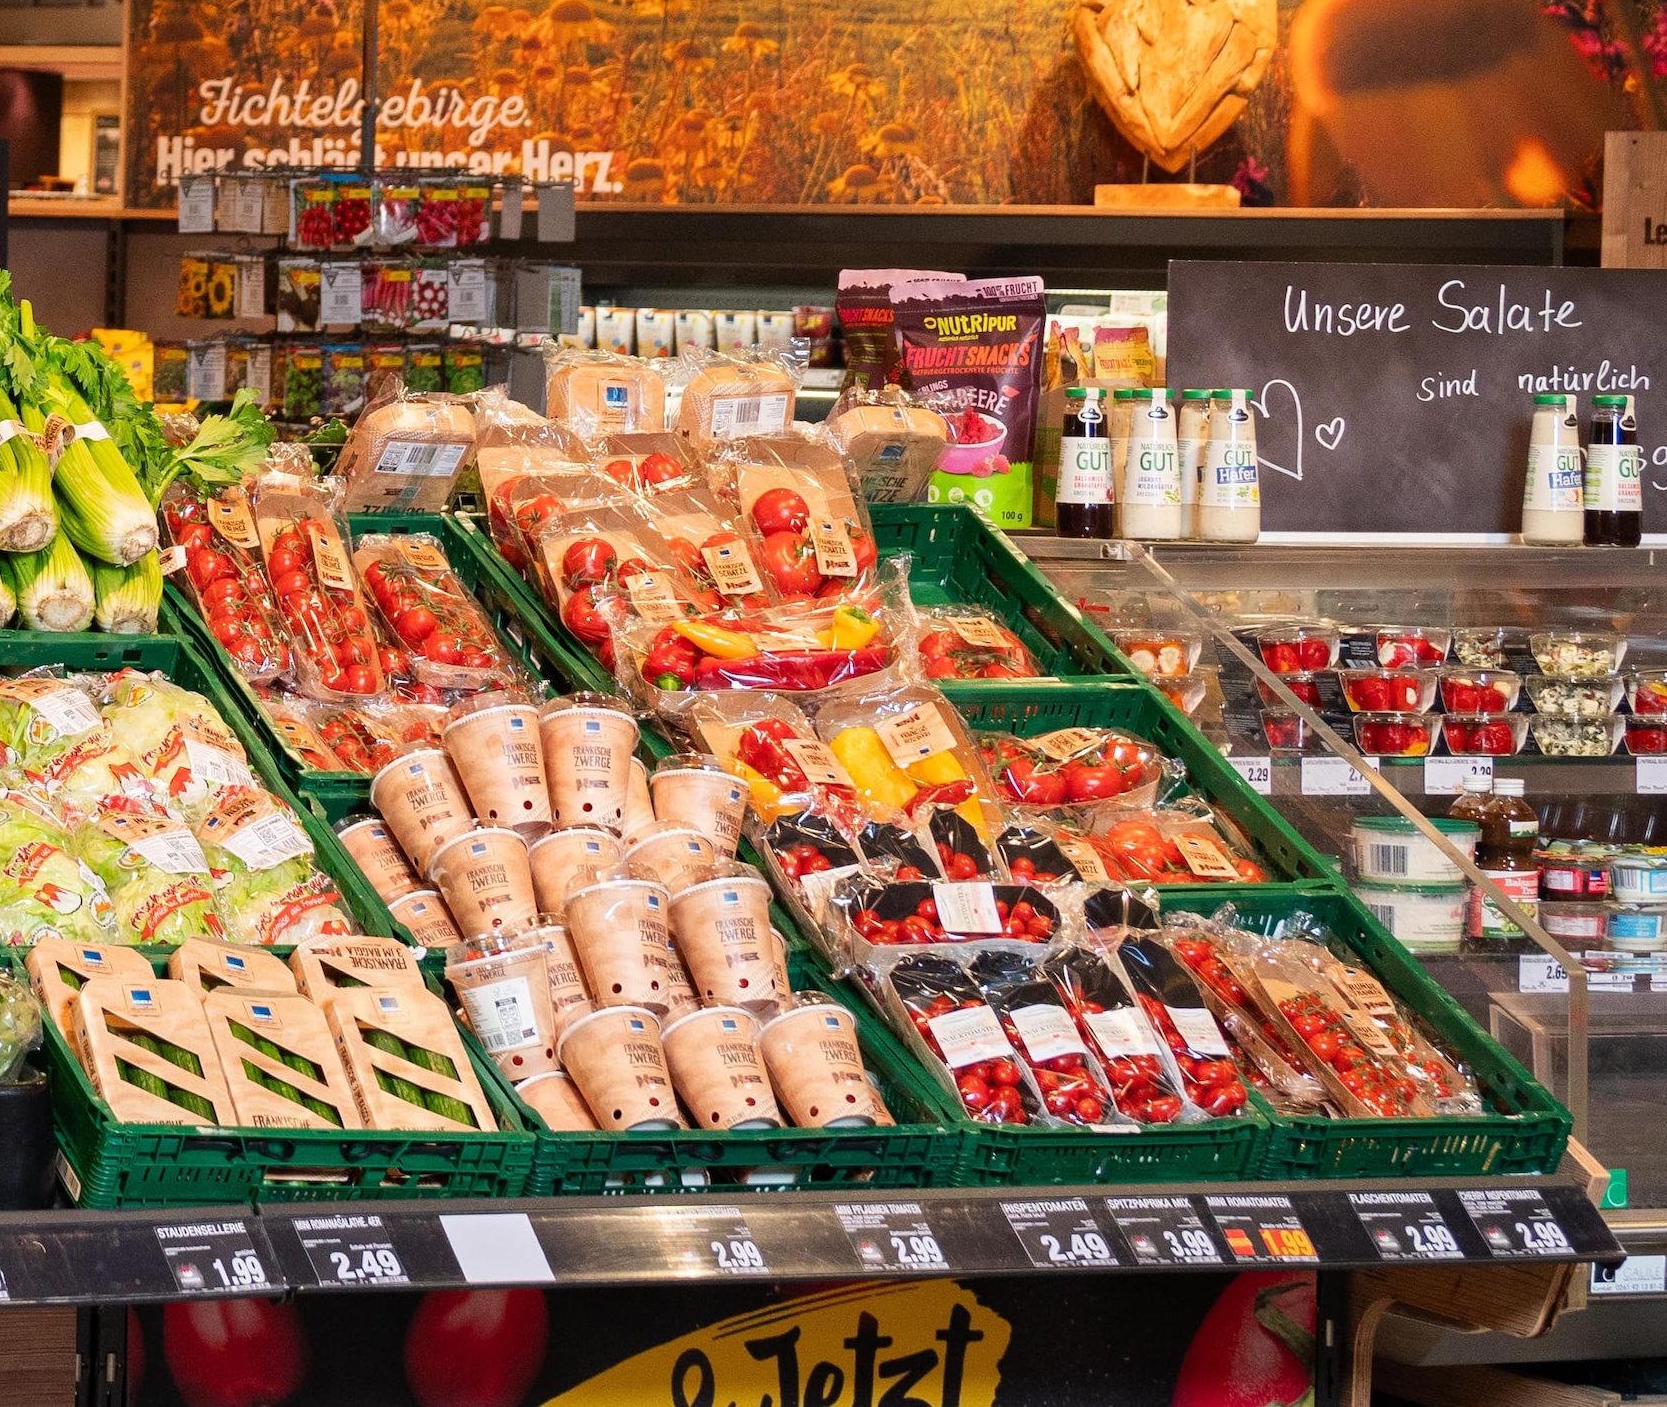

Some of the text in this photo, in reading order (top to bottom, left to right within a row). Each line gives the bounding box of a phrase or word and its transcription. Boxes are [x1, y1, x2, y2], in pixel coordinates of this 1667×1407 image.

[156, 136, 235, 187] Hier
[521, 139, 624, 194] Herz.
[1005, 281, 1038, 295] FRUCHT
[1284, 279, 1584, 337] Unsere Salate
[904, 342, 1030, 370] FRUCHTSNACKS
[1416, 360, 1650, 402] sind natürlich
[1076, 451, 1108, 471] GUT
[1139, 451, 1174, 471] GUT
[1223, 451, 1252, 466] GUT
[1218, 467, 1255, 482] Hafer
[1619, 459, 1639, 478] GU
[1001, 511, 1023, 522] 100 g
[574, 757, 611, 769] ZWERGE
[1248, 768, 1268, 782] 2.29
[470, 875, 509, 891] ZWERGE
[718, 929, 756, 944] ZWERGE
[629, 1054, 661, 1068] ZWERGE
[723, 1053, 757, 1068] ZWERGE
[825, 1050, 860, 1066] ZWERGE
[1004, 1201, 1088, 1214] RISPENTOMATEN
[1107, 1198, 1193, 1210] SPITZPAPRIKA MIX
[1349, 1192, 1433, 1204] FLASCHENTOMATEN
[157, 1223, 246, 1239] STAUDENSELLERIE
[1405, 1225, 1458, 1252] 2.99
[1515, 1221, 1568, 1248] 2.99
[890, 1236, 944, 1264] 2.99
[1040, 1231, 1110, 1261] 2.49
[1163, 1230, 1216, 1257] 3.99
[1262, 1229, 1314, 1256] 1.99
[711, 1240, 764, 1268] 2.99
[213, 1256, 266, 1286] 1.99
[330, 1250, 402, 1280] 2.49
